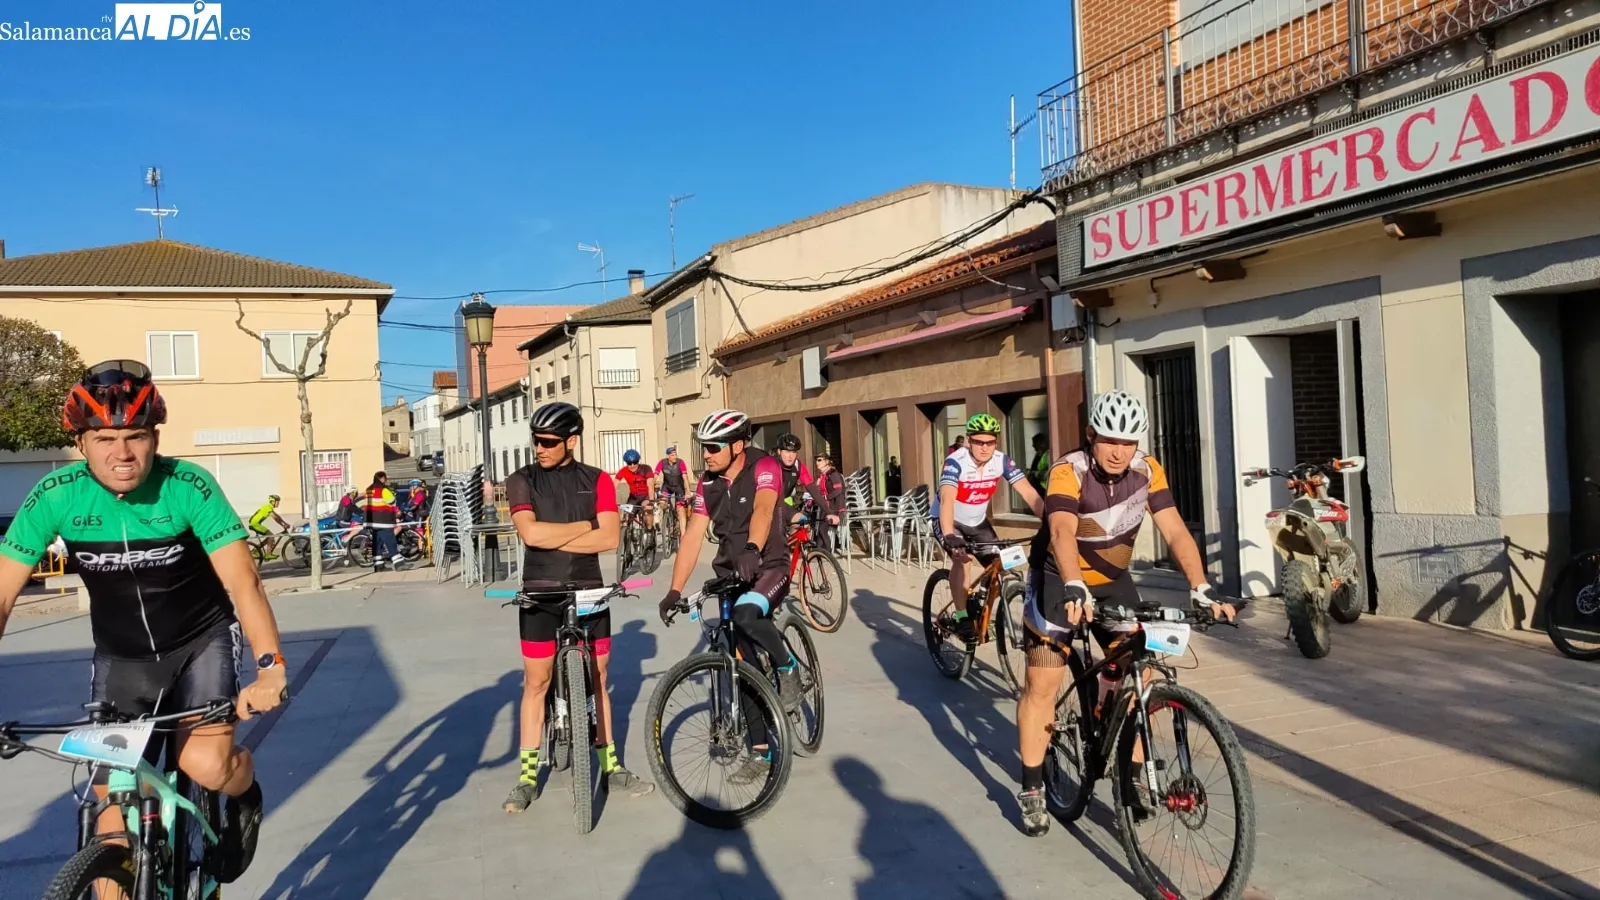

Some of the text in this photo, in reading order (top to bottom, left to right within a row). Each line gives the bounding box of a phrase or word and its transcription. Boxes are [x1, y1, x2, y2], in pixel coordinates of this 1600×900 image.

[1090, 55, 1600, 260] SUPERMERCAD
[75, 544, 185, 565] ORBEA
[132, 559, 165, 569] TEAM
